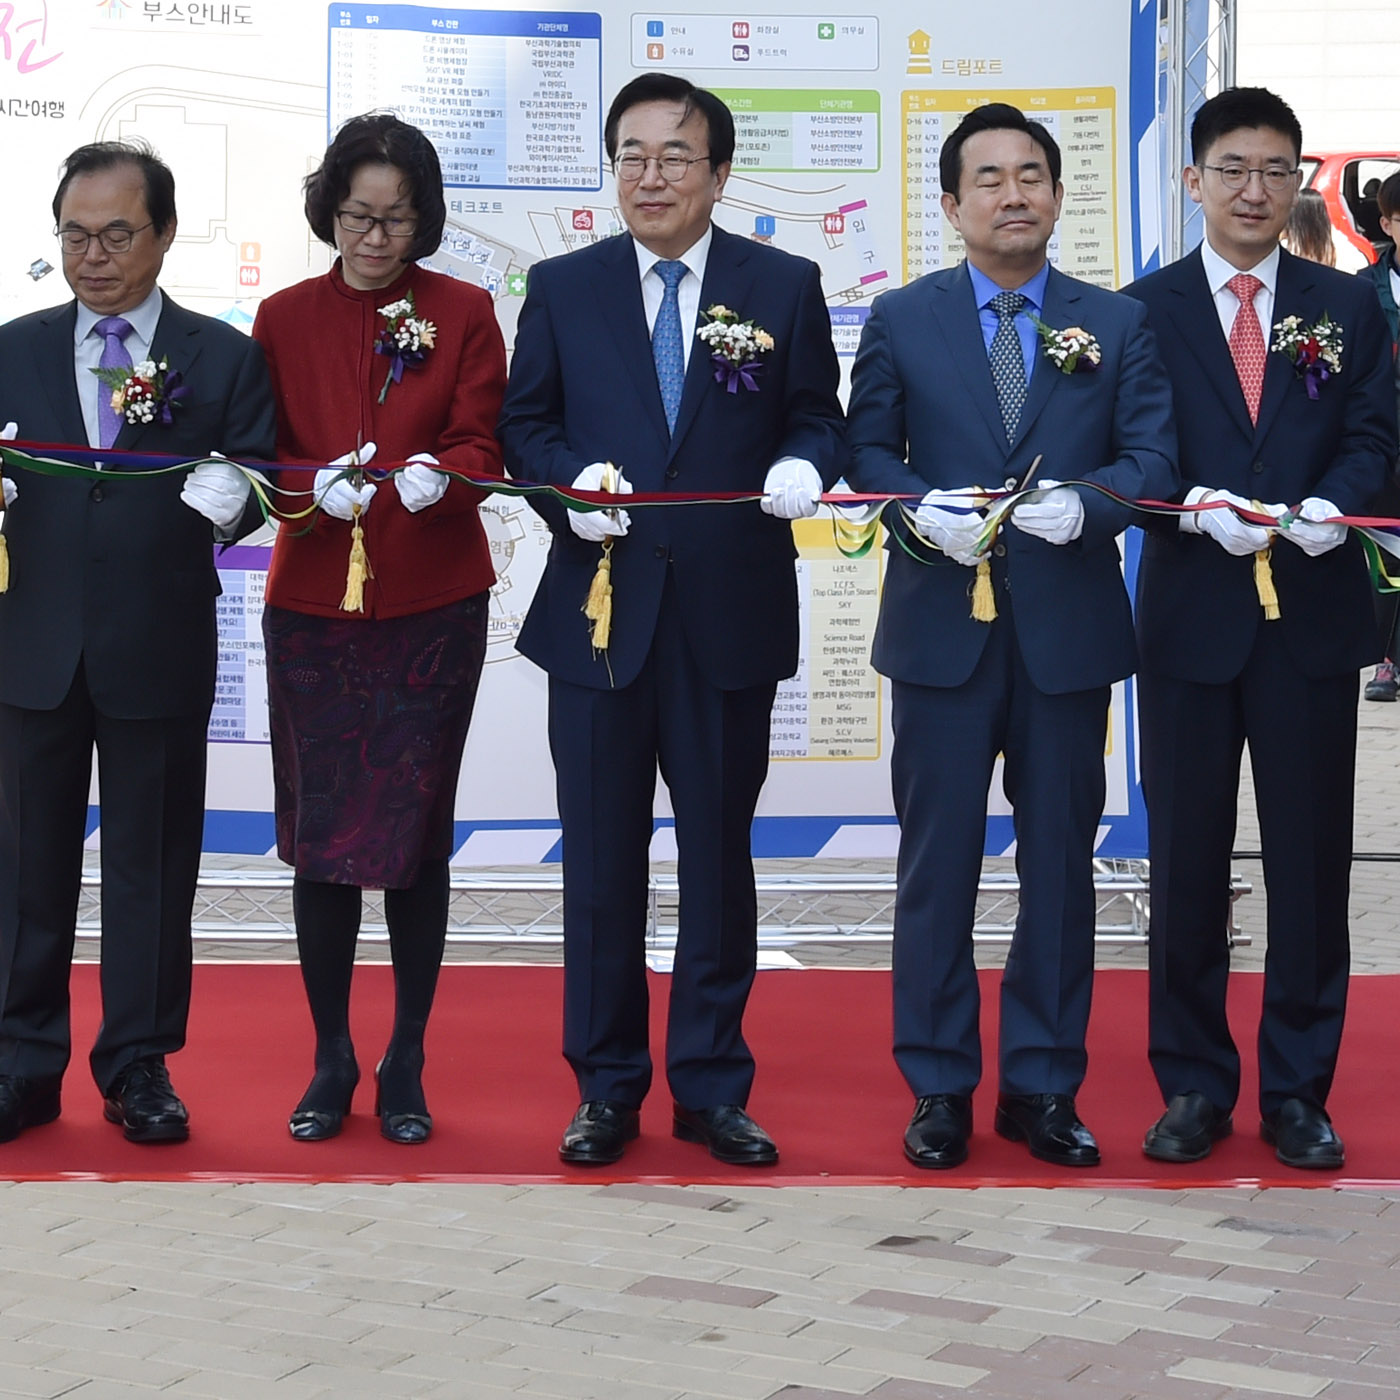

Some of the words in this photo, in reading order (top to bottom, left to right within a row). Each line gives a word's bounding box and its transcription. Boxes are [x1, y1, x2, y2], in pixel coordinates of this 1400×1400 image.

[142, 1, 253, 25] 부스안내도
[671, 26, 686, 35] 안내
[757, 26, 780, 35] 화장실
[842, 26, 864, 35] 의무실
[532, 50, 575, 58] 국립부산과학관
[671, 47, 694, 56] 수유실
[532, 60, 575, 68] 국립부산과학관
[941, 59, 1003, 76] 드림포트
[450, 200, 504, 213] 테크포트
[824, 634, 847, 642] Science
[849, 633, 865, 641] Road
